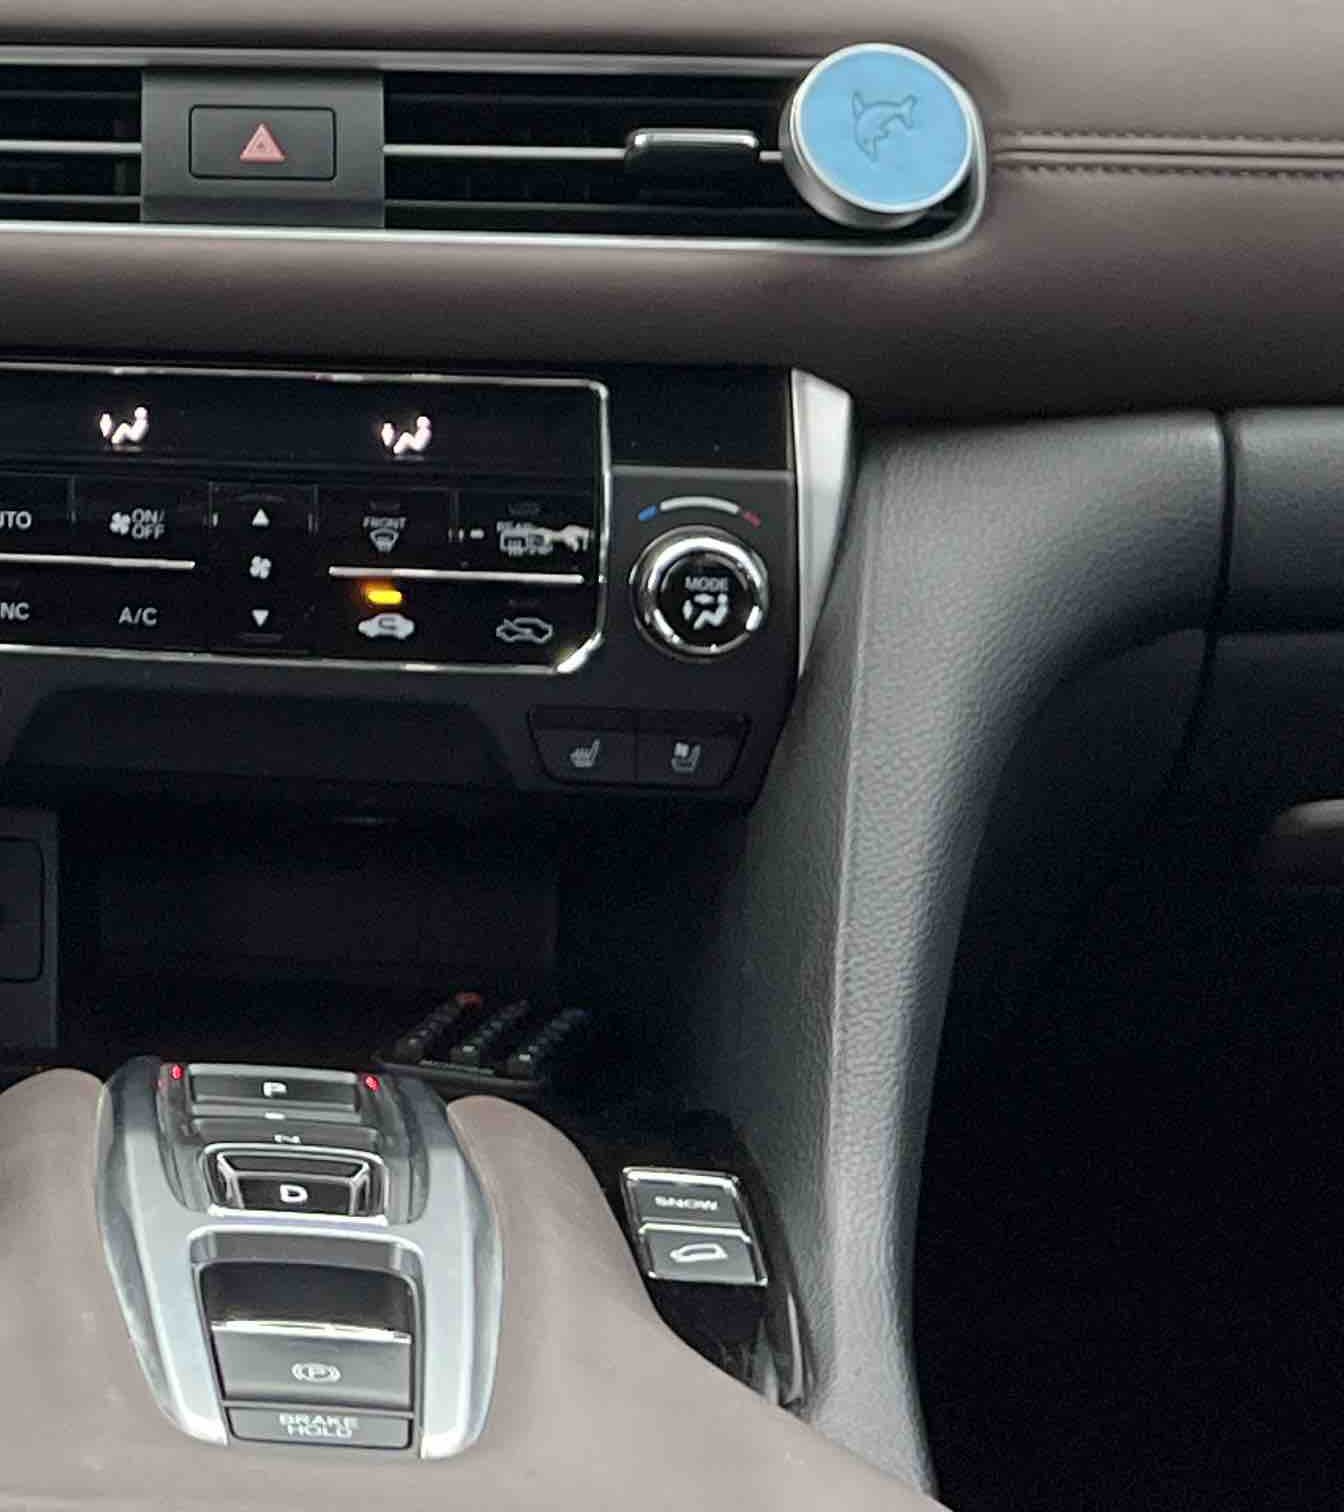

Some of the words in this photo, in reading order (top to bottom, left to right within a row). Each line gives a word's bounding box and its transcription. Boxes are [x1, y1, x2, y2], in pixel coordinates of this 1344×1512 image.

[363, 516, 406, 529] FRONT
[130, 523, 166, 539] OFF
[685, 576, 729, 593] MODE
[118, 606, 159, 626] A/C
[262, 1081, 287, 1097] P
[279, 1183, 309, 1203] D
[654, 1195, 718, 1211] SNOW
[278, 1412, 360, 1429] BRAKE
[287, 1424, 353, 1438] HOLD
